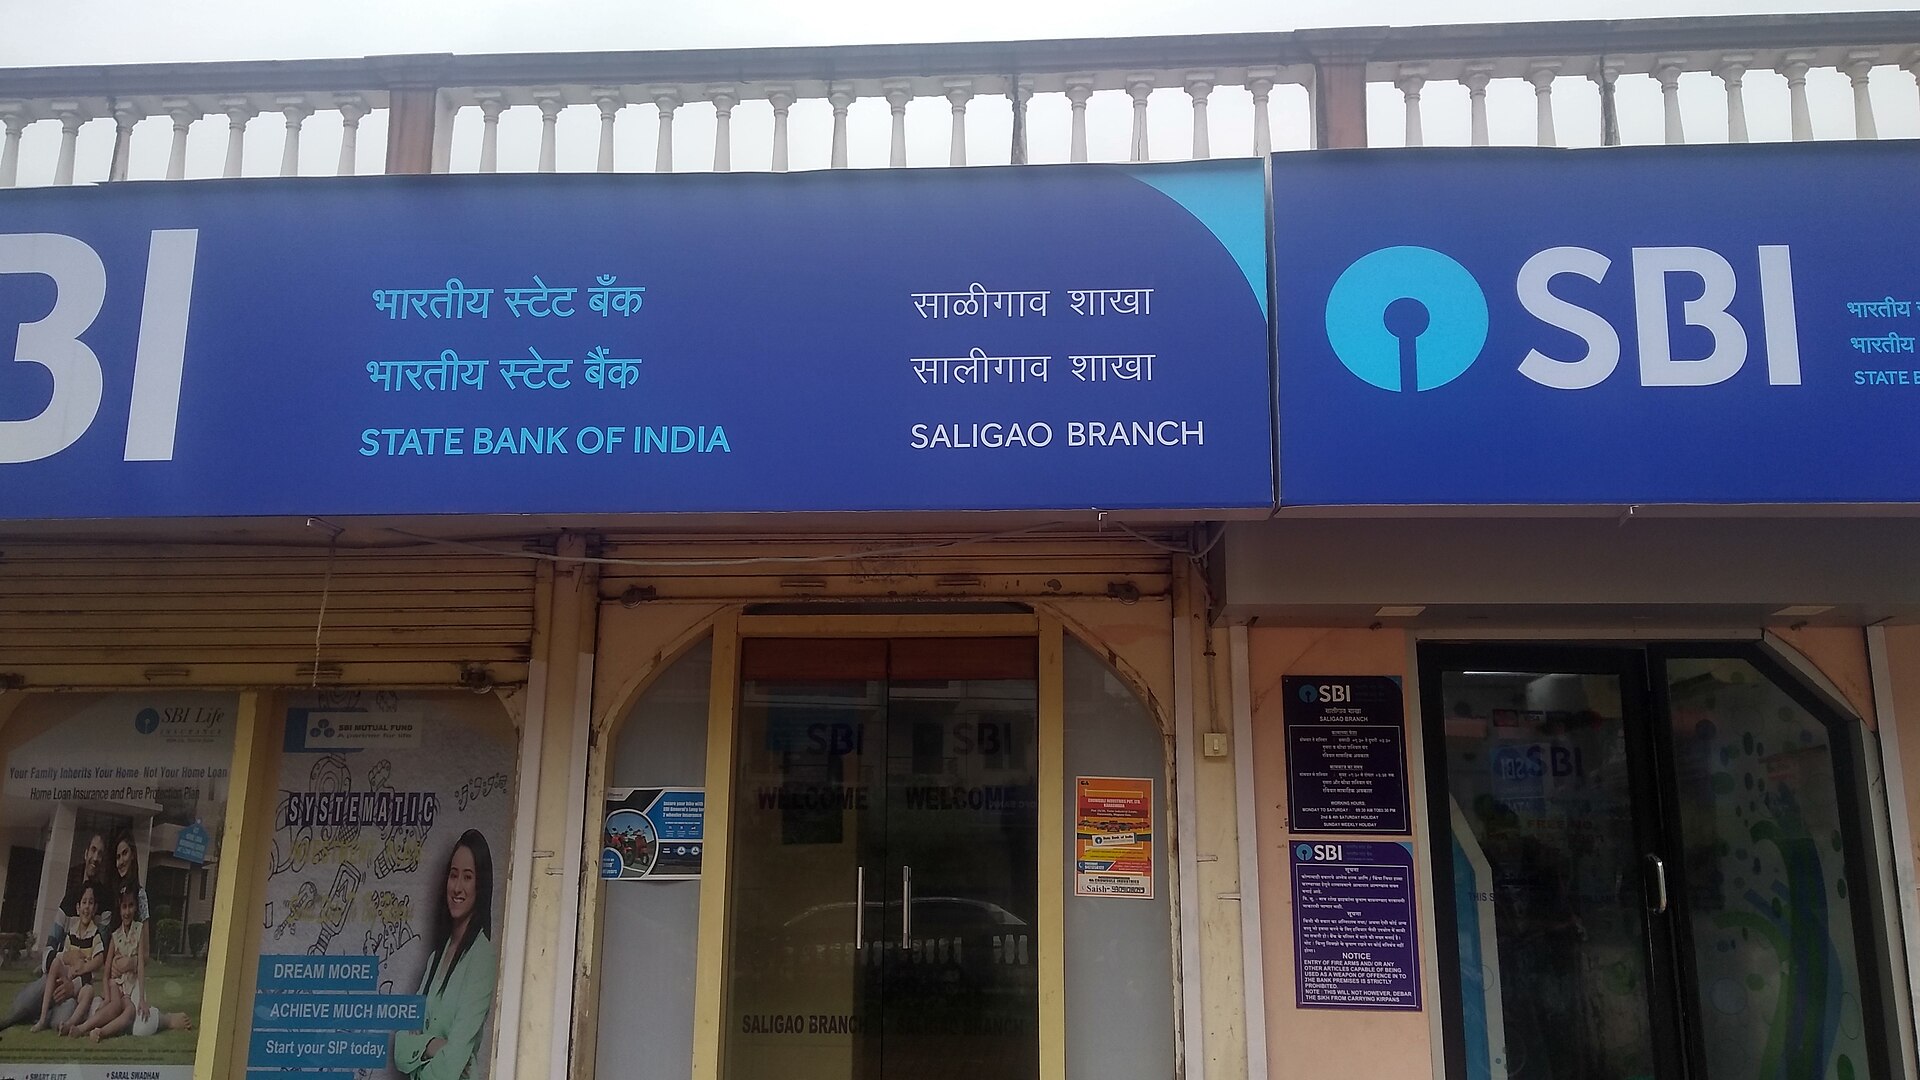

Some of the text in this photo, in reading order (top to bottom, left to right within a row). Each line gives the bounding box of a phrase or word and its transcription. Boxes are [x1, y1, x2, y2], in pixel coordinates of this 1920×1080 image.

[372, 273, 646, 319] भारतीय स्टेट बँक
[910, 282, 1154, 319] साळीगाव शाखा
[1516, 245, 1802, 390] SBI
[1847, 296, 1911, 318] भारतीय
[1850, 332, 1915, 353] भारतीय
[366, 345, 642, 391] भारतीय स्टेट बैंक
[910, 347, 1156, 384] सालीगाव शाखा
[1854, 370, 1910, 385] STATE
[358, 425, 731, 456] STATE BANK OF INDIA
[910, 420, 1204, 449] SALIGAO BRANCH
[1319, 685, 1351, 703] SBI
[162, 707, 224, 728] SBI Life
[338, 724, 413, 732] SBI MUTUAL FUND
[807, 722, 864, 756] SBI
[952, 722, 1011, 755] SBI
[1526, 744, 1584, 778] SBI
[10, 766, 228, 782] Your Family Inherits Your Home Not Your Home Loan
[30, 787, 51, 800] Home
[53, 787, 71, 800] Loan
[73, 787, 109, 800] Insurance
[111, 787, 125, 800] and
[126, 787, 143, 800] Pure
[184, 787, 200, 800] Plan
[758, 786, 868, 810] WELCOME
[905, 786, 1017, 810] WELCOME
[287, 795, 435, 824] SYSTEMATIC
[1313, 844, 1343, 861] SBI
[1342, 952, 1371, 960] NOTICE
[274, 964, 374, 980] DREAM MORE.
[270, 1003, 420, 1020] ACHIEVE MUCH MORE.
[742, 1014, 868, 1034] SALIGAO BRANCH
[266, 1040, 386, 1058] Start your SIP today.
[110, 1072, 130, 1080] SARAL
